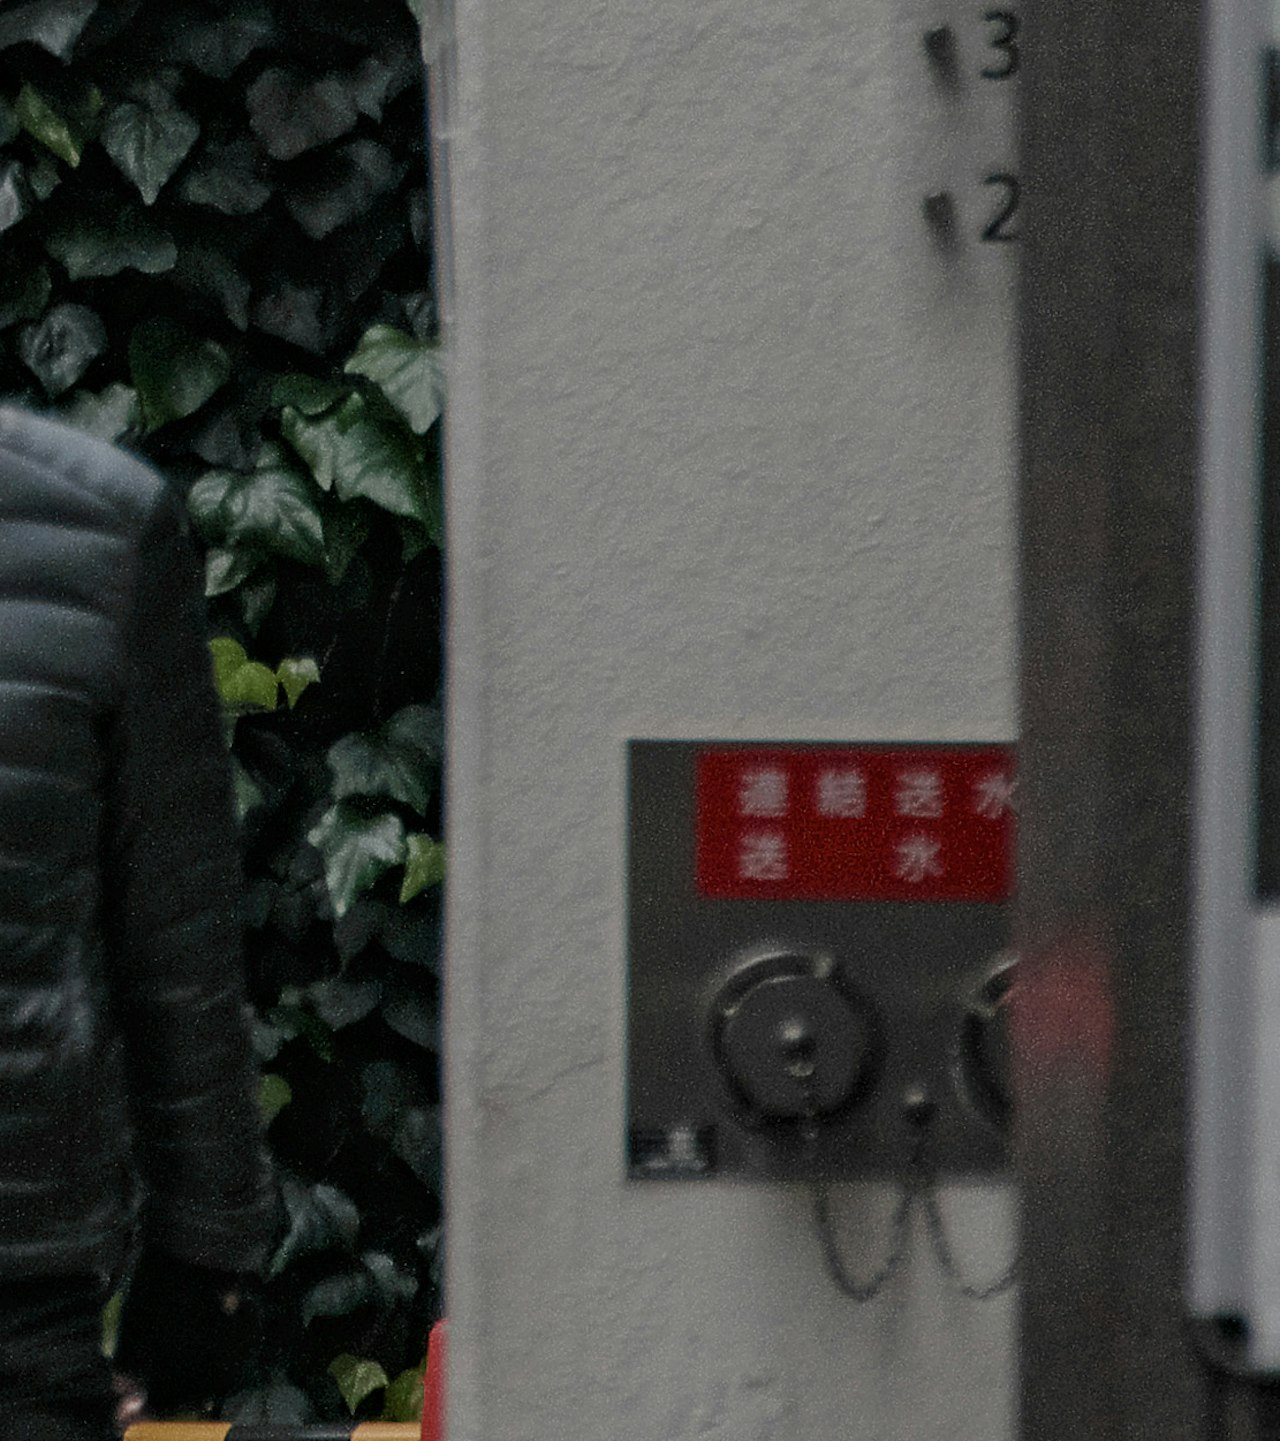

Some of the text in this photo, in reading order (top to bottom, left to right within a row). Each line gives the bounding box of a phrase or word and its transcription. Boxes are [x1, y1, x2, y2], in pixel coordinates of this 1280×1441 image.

[980, 9, 1022, 80] 3
[980, 173, 1021, 244] 2
[739, 770, 1017, 819] 送水
